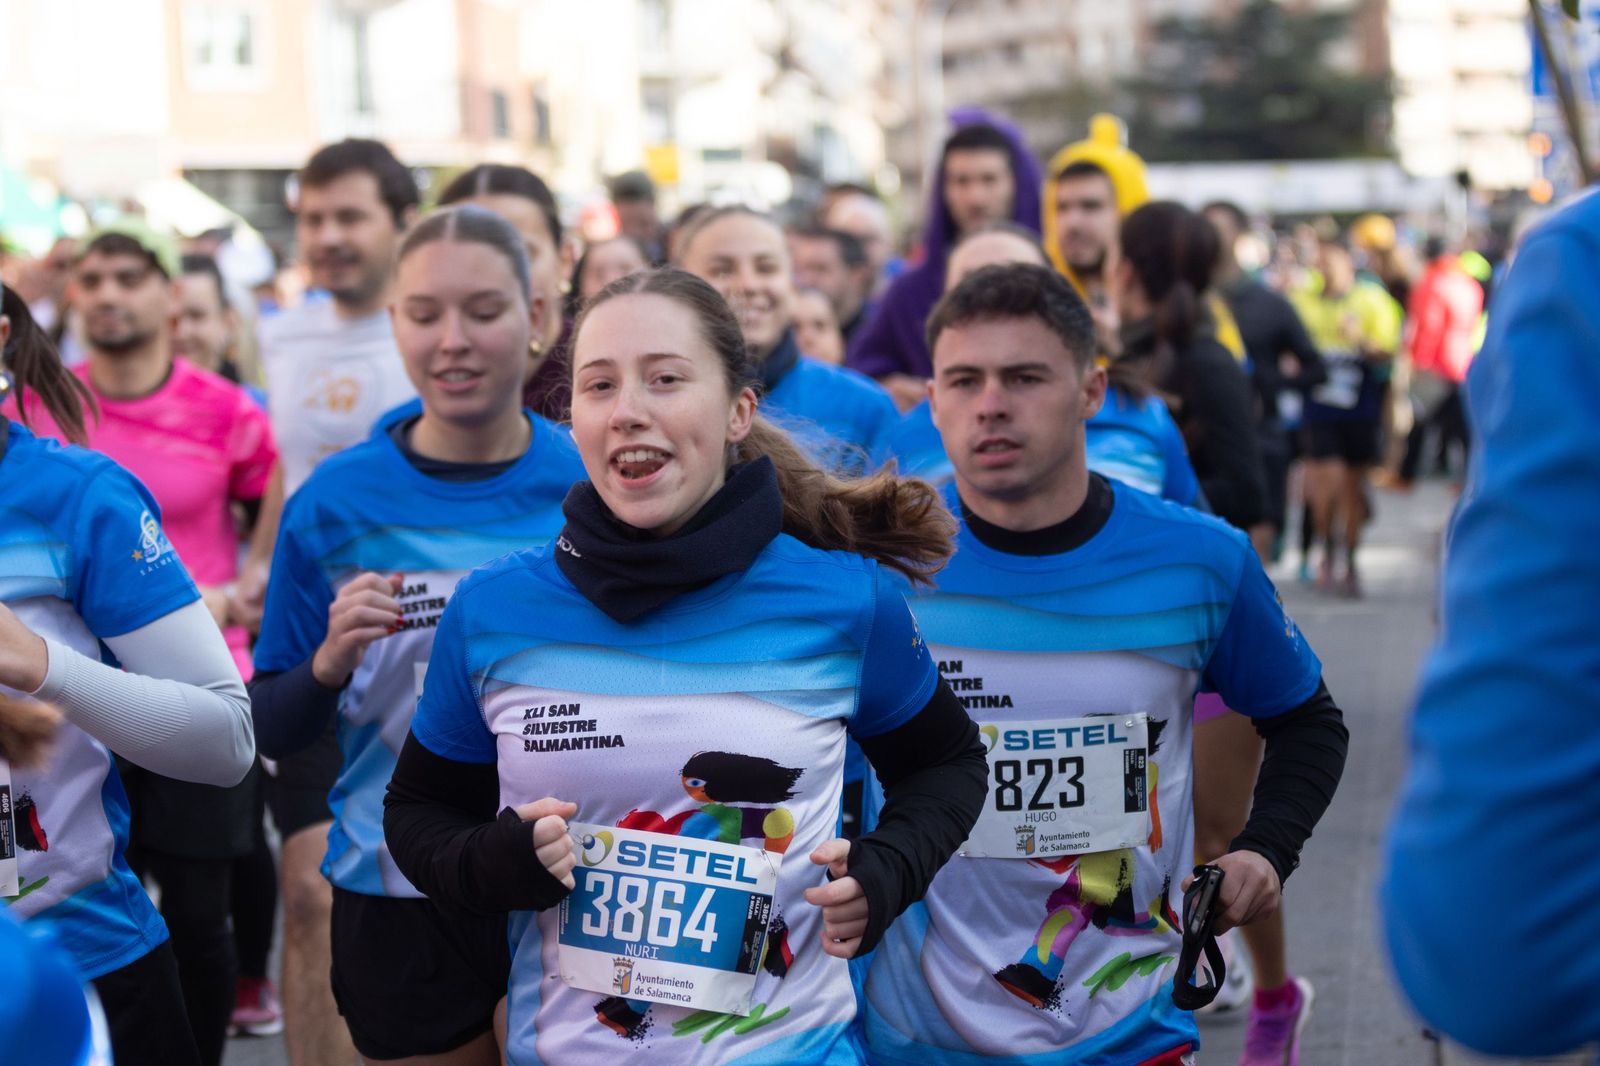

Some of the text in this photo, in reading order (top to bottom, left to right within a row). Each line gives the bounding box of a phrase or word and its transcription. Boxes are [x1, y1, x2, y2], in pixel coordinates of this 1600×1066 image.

[937, 661, 963, 673] AN
[523, 703, 581, 720] XLI SAN
[522, 719, 598, 736] SILVESTRE
[524, 735, 625, 753] SALMANTINA
[1003, 723, 1128, 751] SETEL
[994, 756, 1085, 812] 823
[1025, 811, 1057, 823] HUGO
[1039, 831, 1090, 844] Ayuntamiento
[1051, 842, 1090, 851] Salamanca
[616, 840, 758, 885] SETEL
[582, 871, 718, 953] 3864
[760, 903, 770, 925] 3864
[624, 943, 660, 960] NURI
[635, 972, 694, 990] Ayuntamiento
[634, 986, 692, 1003] de Salamanca
